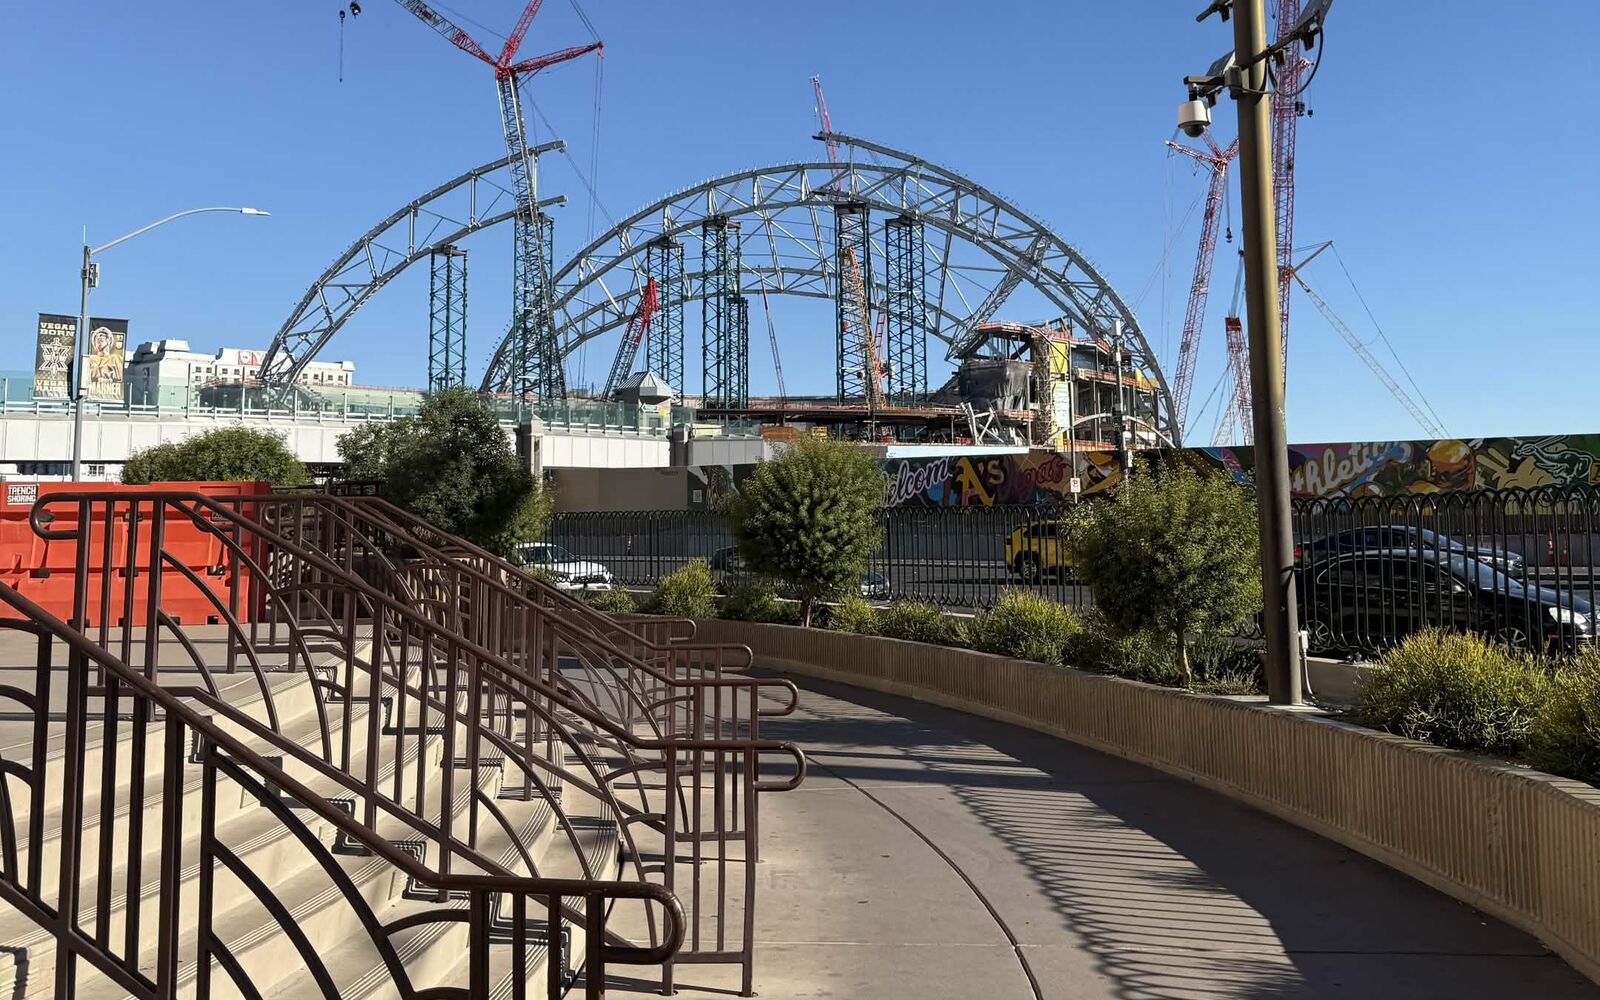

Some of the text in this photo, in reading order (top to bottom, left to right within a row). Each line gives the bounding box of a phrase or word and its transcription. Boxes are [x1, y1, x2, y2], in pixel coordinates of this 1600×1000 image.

[40, 322, 75, 330] VEGAS
[8, 486, 36, 495] TRENCH
[7, 495, 36, 503] SHORING
